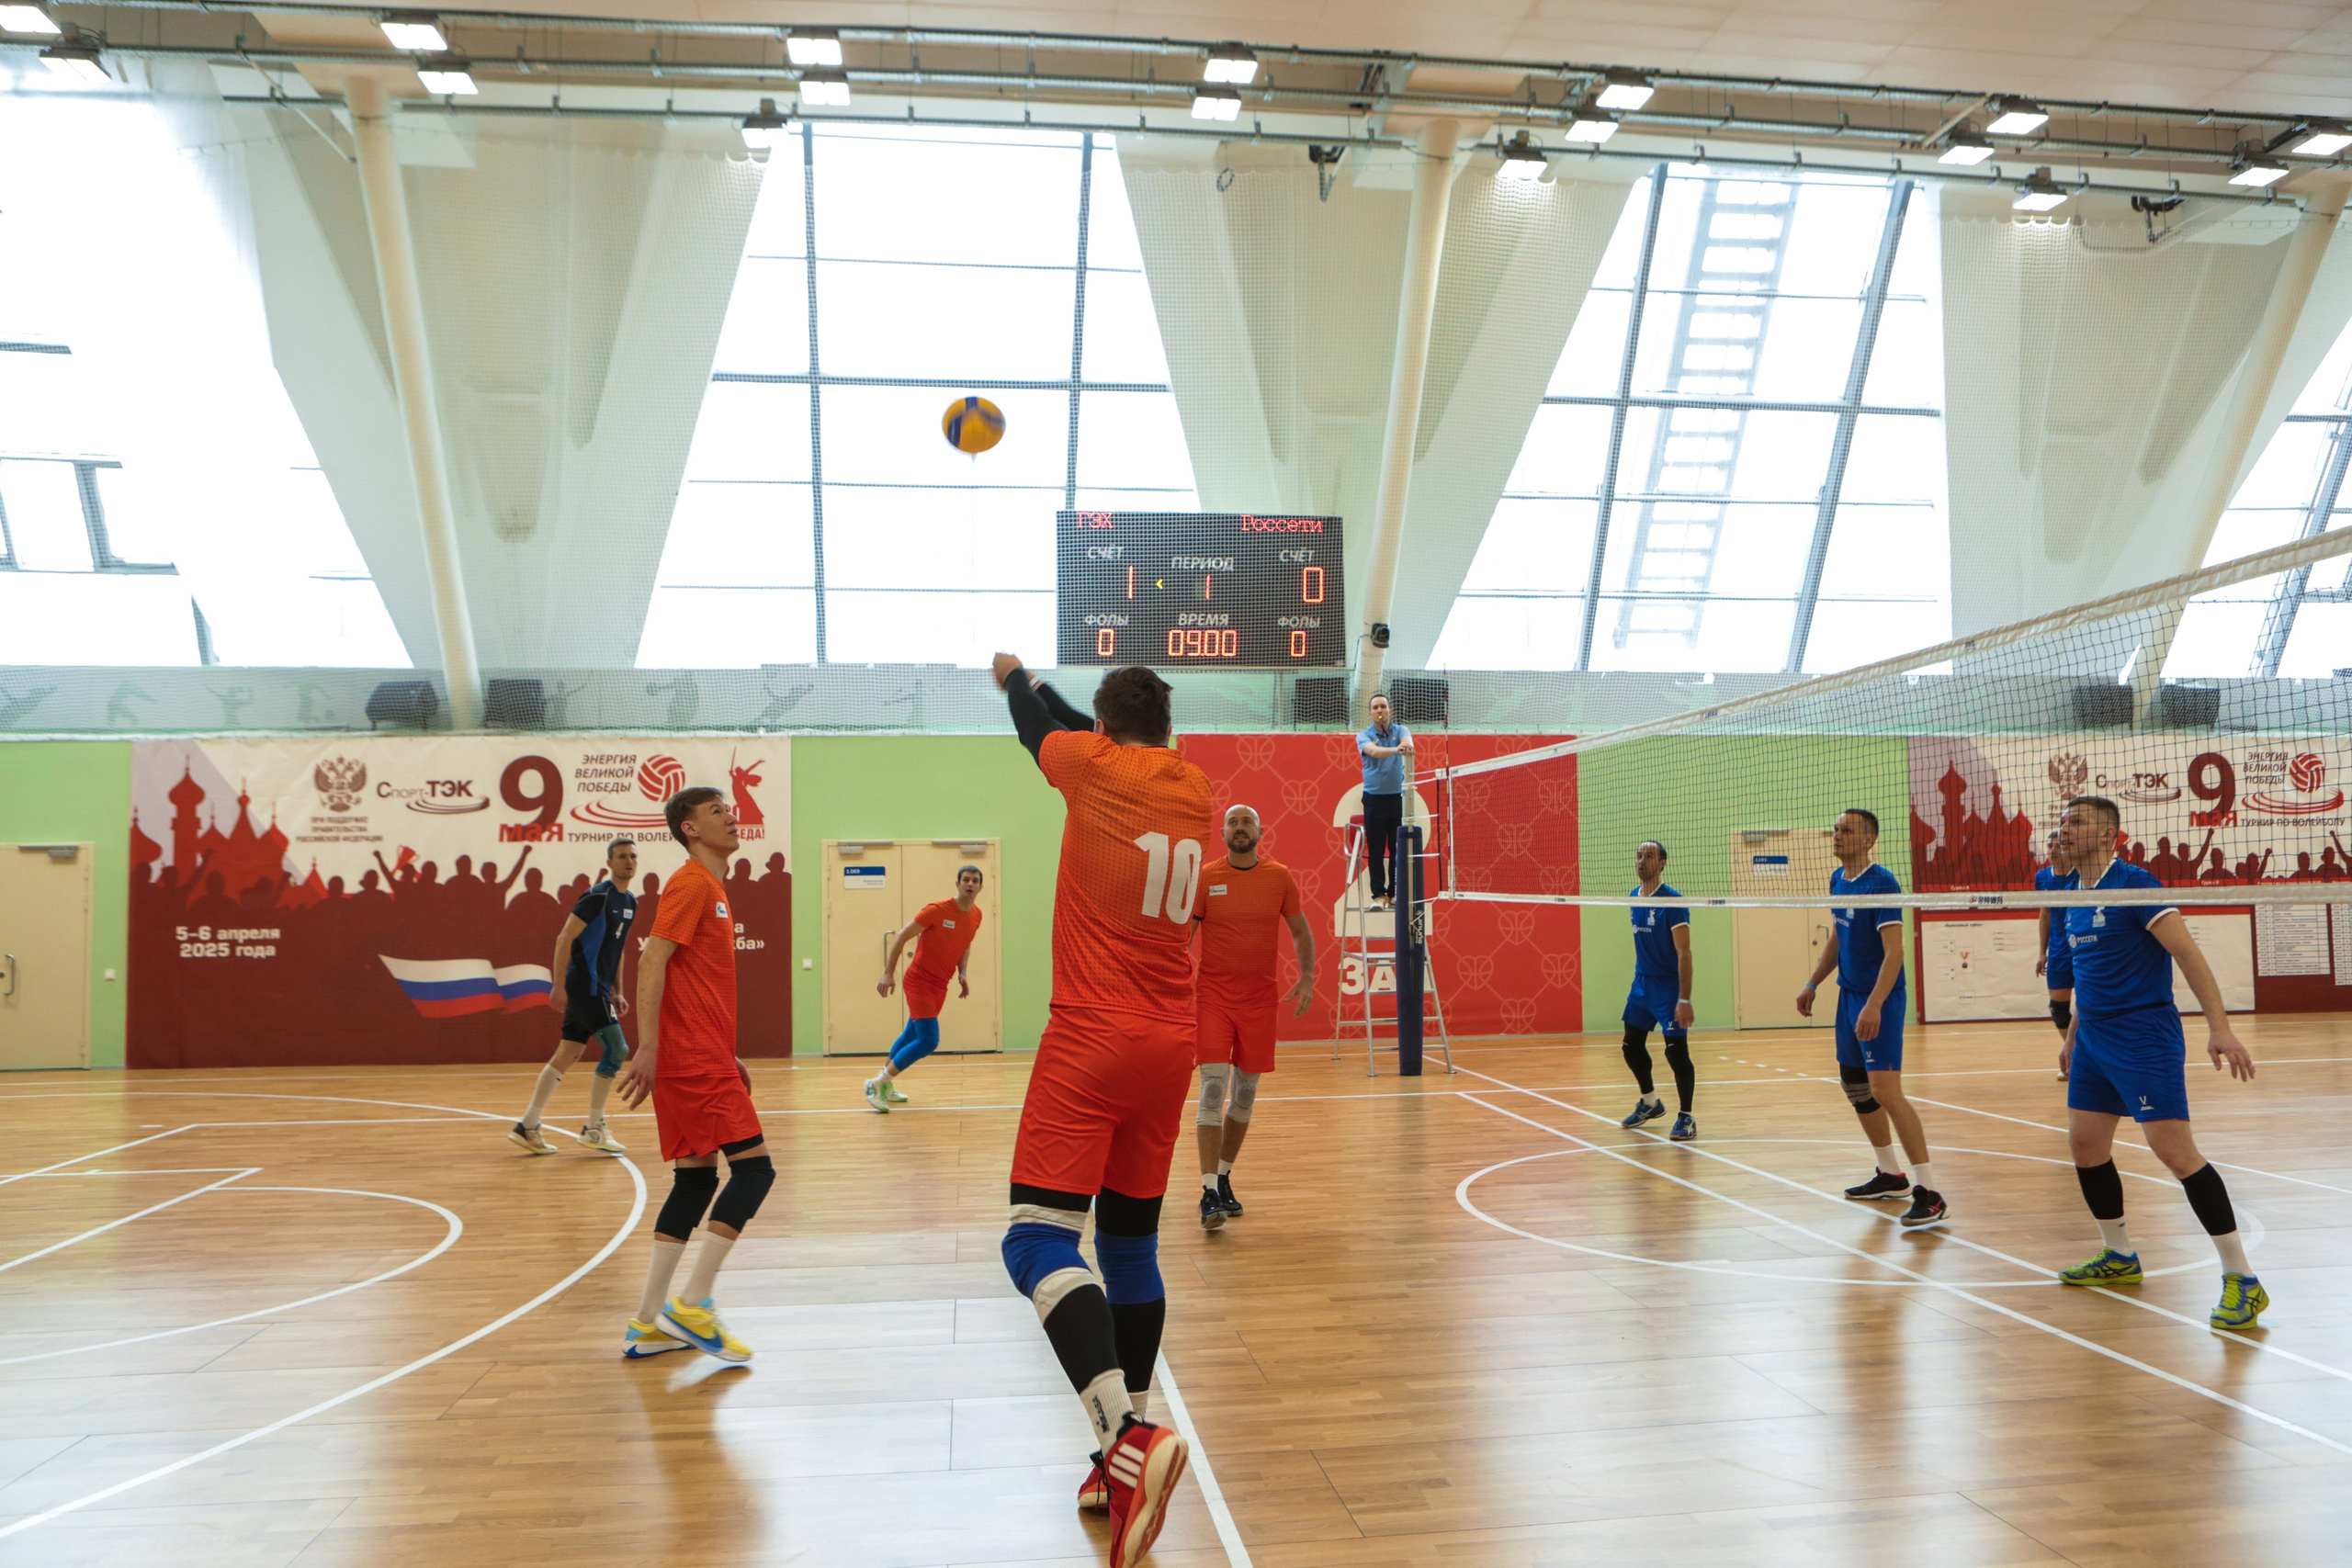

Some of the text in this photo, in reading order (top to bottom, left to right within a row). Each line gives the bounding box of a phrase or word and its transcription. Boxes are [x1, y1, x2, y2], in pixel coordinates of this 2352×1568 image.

[1241, 514, 1323, 533] Россети
[1280, 547, 1315, 562] СЧЁТ
[1171, 557, 1234, 571] ПЕРИОД
[1303, 567, 1324, 603] 0
[1085, 614, 1129, 626] ФОЛЫ
[1179, 614, 1228, 626] ВРЕМЯ
[1278, 616, 1320, 628] ФОЛЫ
[1098, 628, 1114, 656] 0
[1291, 631, 1306, 657] 0
[582, 754, 637, 764] ЭНЕРГИЯ
[2247, 751, 2288, 761] ЭНЕРГИЯ
[574, 766, 634, 778] ВЕЛИКОЙ
[2244, 762, 2287, 773] ВЕЛИКОЙ
[2245, 775, 2285, 785] ПОБЕДЫ
[577, 782, 631, 794] ПОБЕДЫ
[2188, 752, 2236, 827] 9
[499, 755, 563, 841] 9
[2241, 817, 2346, 827] ТУРНИР ПО ВОЛЕЙБОЛУ
[568, 832, 613, 842] ТУРНИР
[1134, 831, 1202, 925] 10
[217, 929, 280, 943] апреля
[615, 921, 624, 940] 4
[2076, 935, 2098, 943] РОССЕТИ
[179, 942, 277, 958] 2025 года
